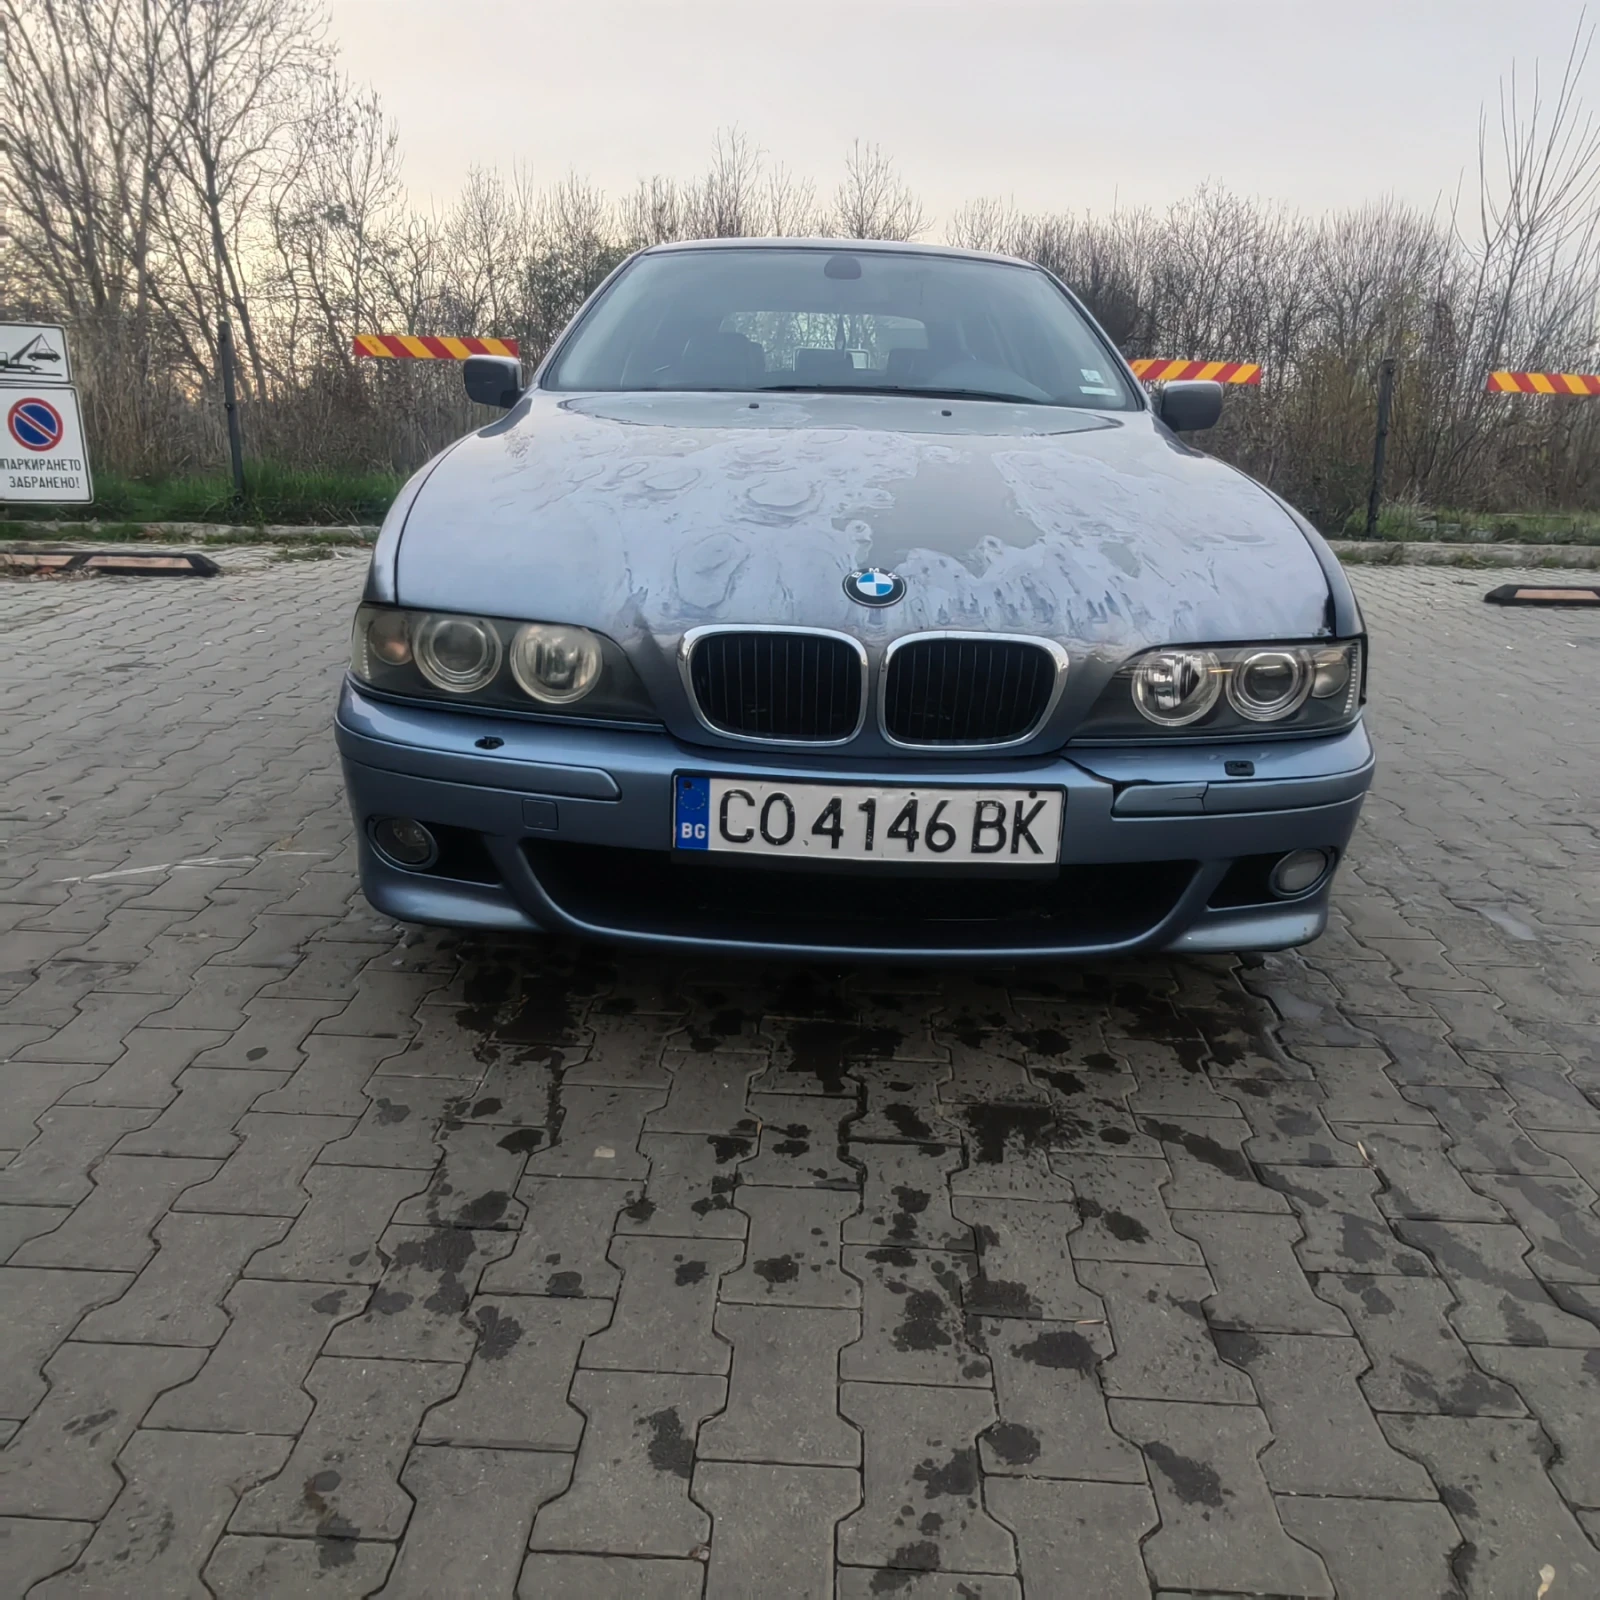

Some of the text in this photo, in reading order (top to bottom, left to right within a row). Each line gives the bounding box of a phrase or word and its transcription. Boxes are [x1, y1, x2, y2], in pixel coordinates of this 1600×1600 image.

[8, 475, 80, 488] ЗАБРАНЕНО!
[851, 567, 899, 580] BMW
[681, 822, 706, 839] BG
[811, 795, 957, 853] 4146
[970, 799, 1048, 855] BK
